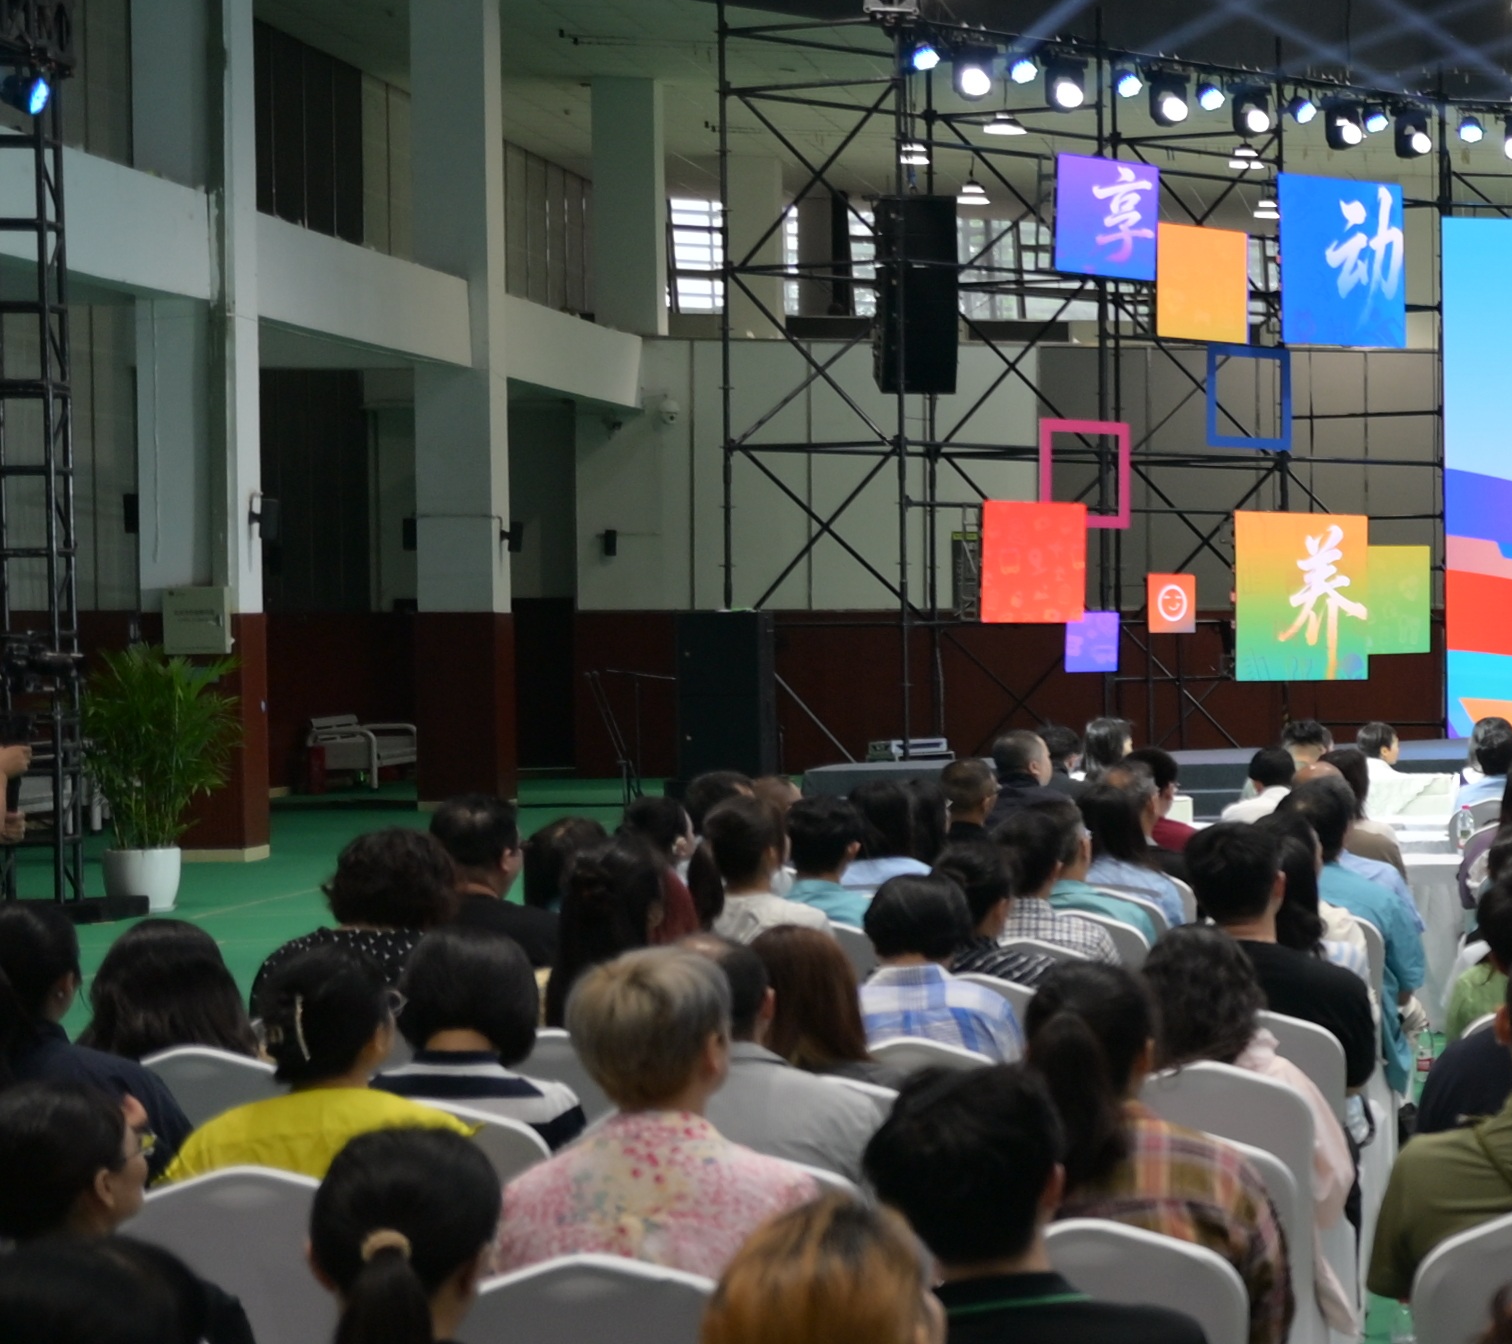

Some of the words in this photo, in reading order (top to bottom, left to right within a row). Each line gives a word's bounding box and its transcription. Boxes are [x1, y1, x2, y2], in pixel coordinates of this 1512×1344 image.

[1092, 166, 1155, 262] 享
[1325, 185, 1404, 326] 动
[1278, 523, 1368, 680] 养
